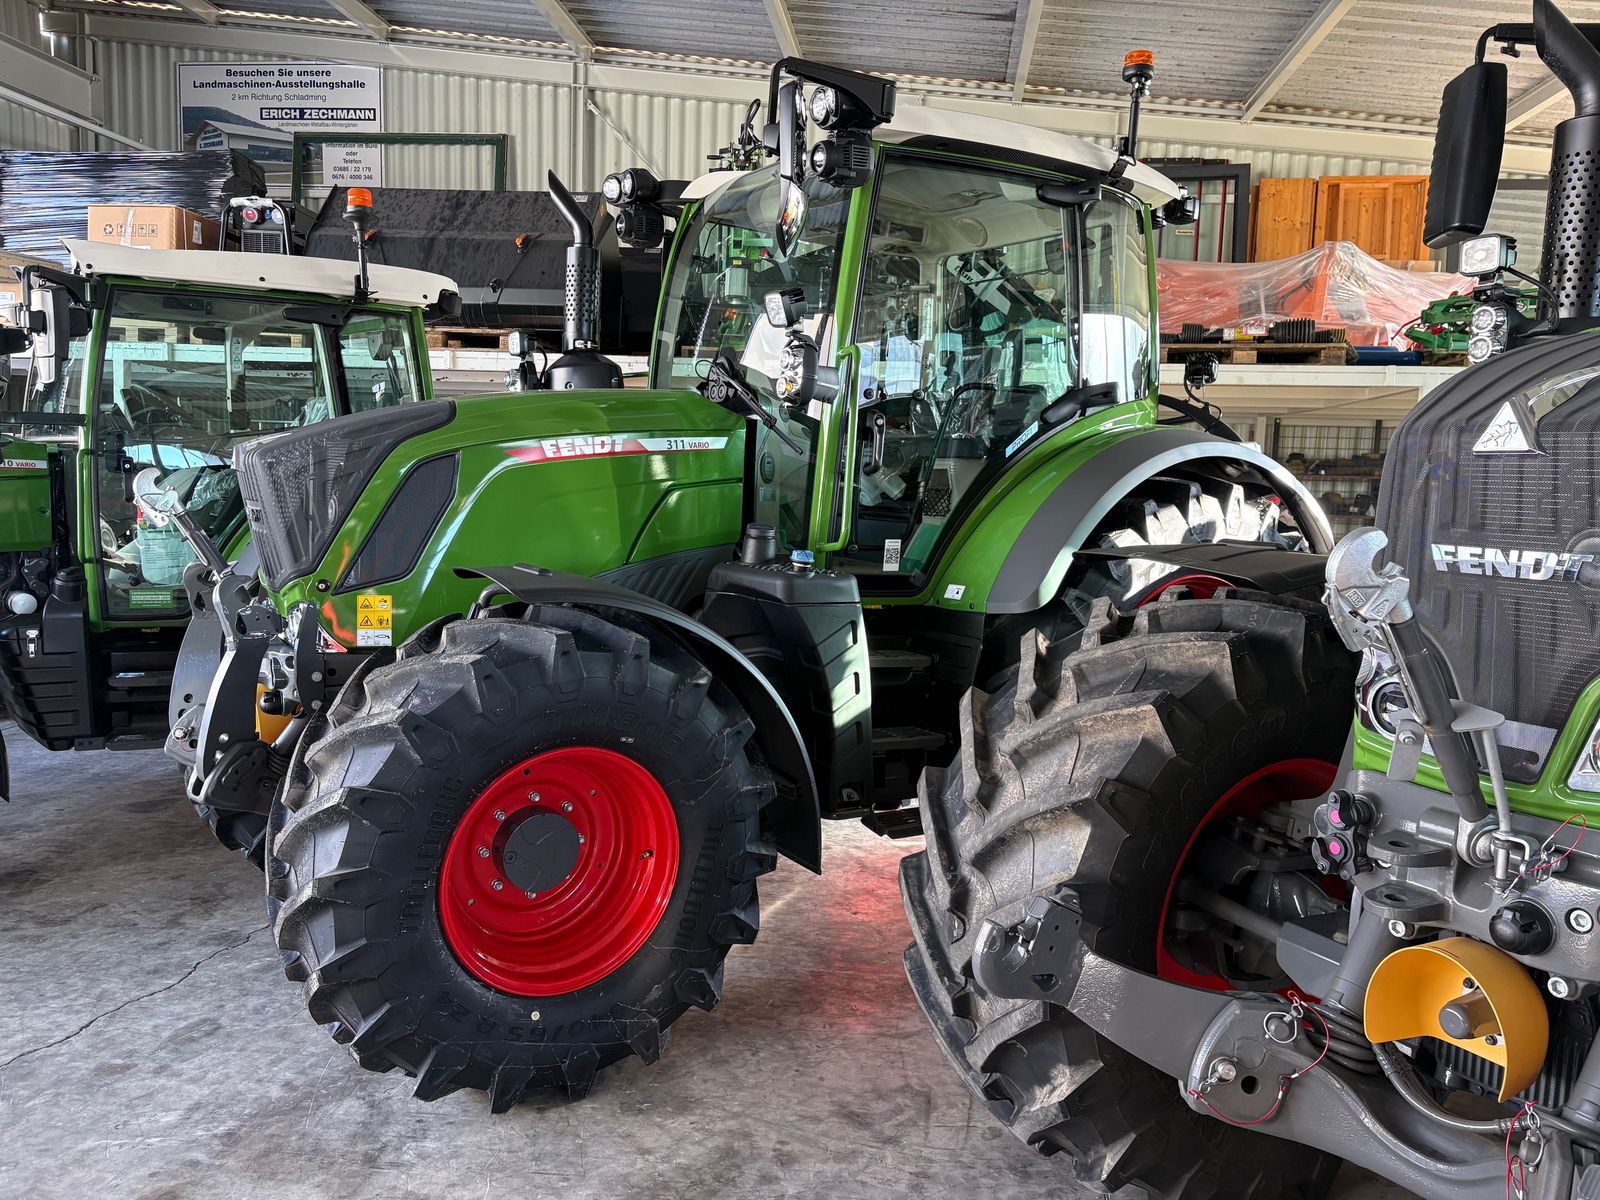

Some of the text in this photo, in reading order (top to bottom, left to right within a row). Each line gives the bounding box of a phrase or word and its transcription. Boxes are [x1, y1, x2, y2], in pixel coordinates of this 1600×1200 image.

[225, 69, 276, 77] Besuchen
[277, 69, 294, 77] Sie
[192, 80, 366, 90] Landmaschinen-Ausstellungshalle
[231, 93, 327, 102] 2 km Richtung Schladming
[261, 109, 375, 120] ERICH ZECHMANN
[540, 435, 710, 458] FENDT 311 VARIO
[3, 459, 14, 467] 10
[1431, 543, 1595, 583] FENDT
